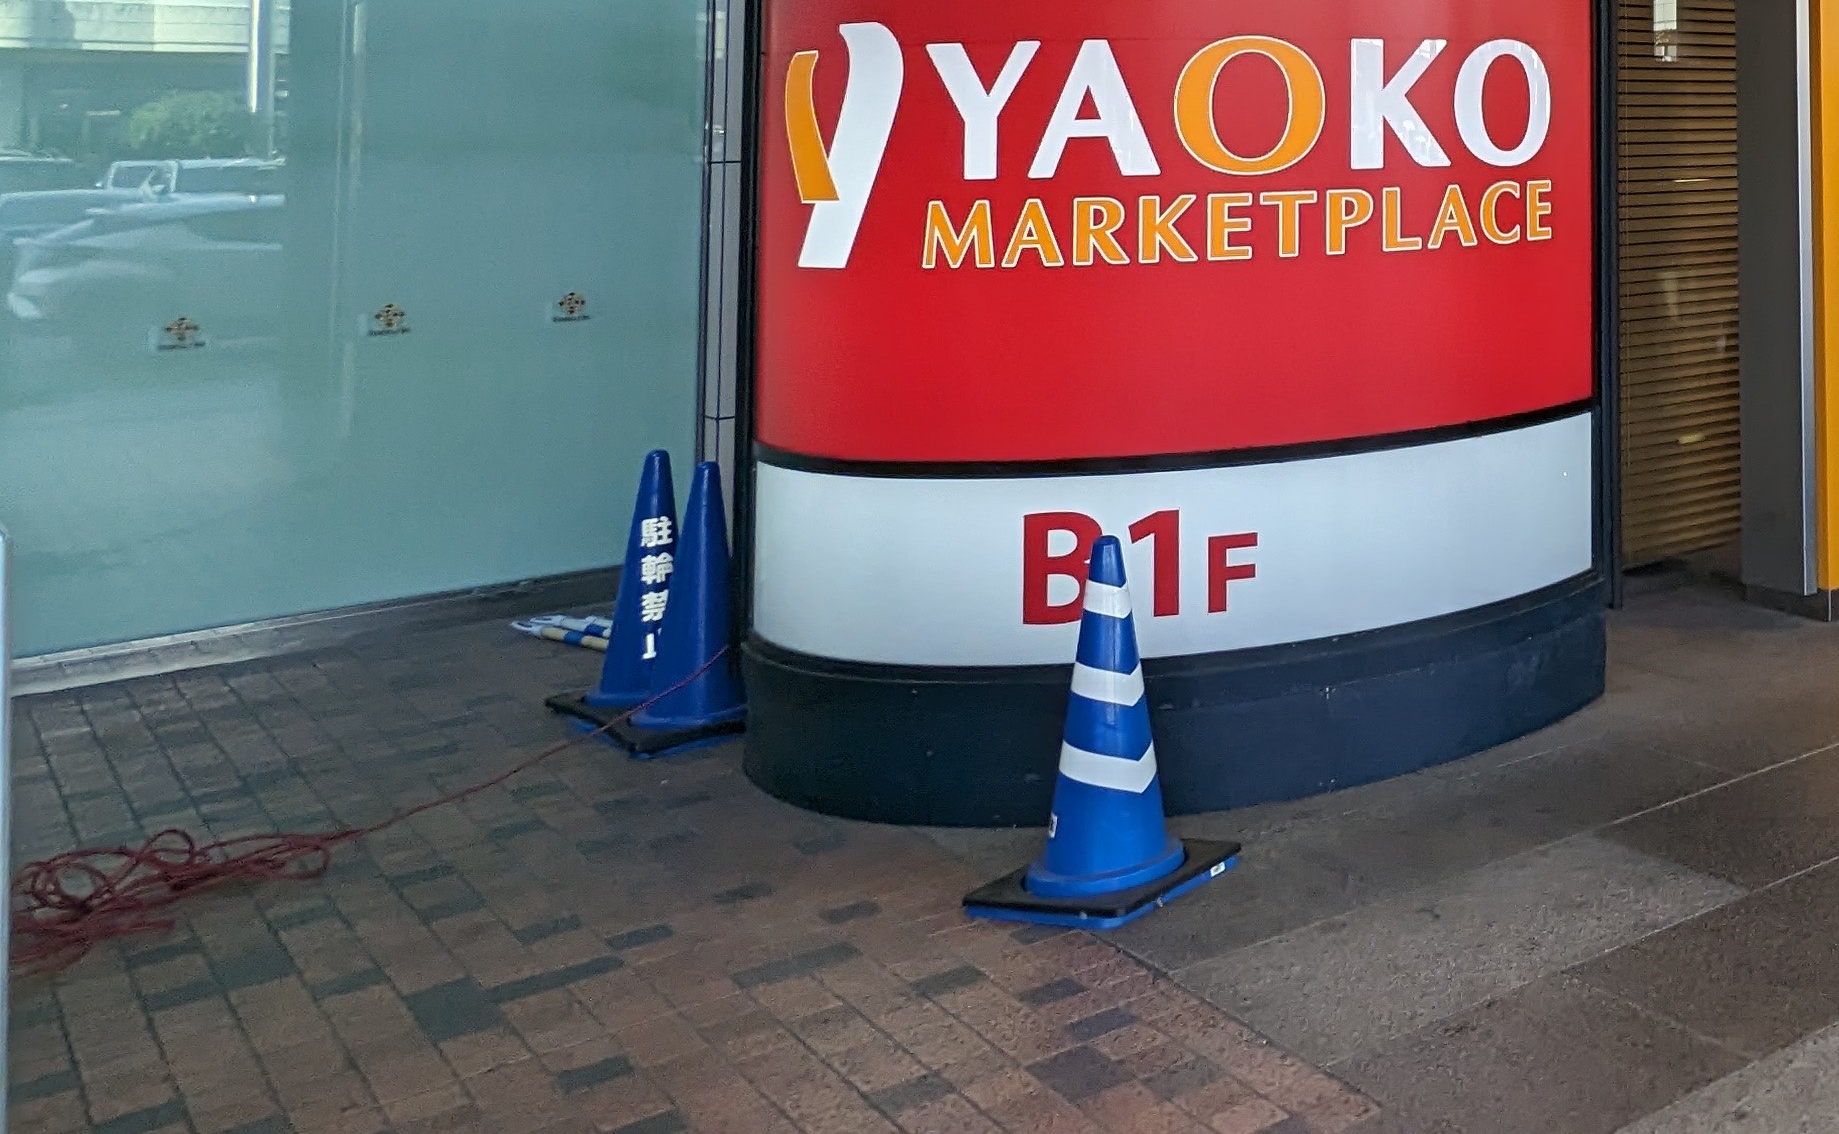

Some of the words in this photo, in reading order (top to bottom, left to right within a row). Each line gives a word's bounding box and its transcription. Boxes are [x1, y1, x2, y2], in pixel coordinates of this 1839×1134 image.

[924, 35, 1552, 179] YAOKO
[921, 179, 1554, 270] MARKETPLACE
[1022, 508, 1259, 626] B1F
